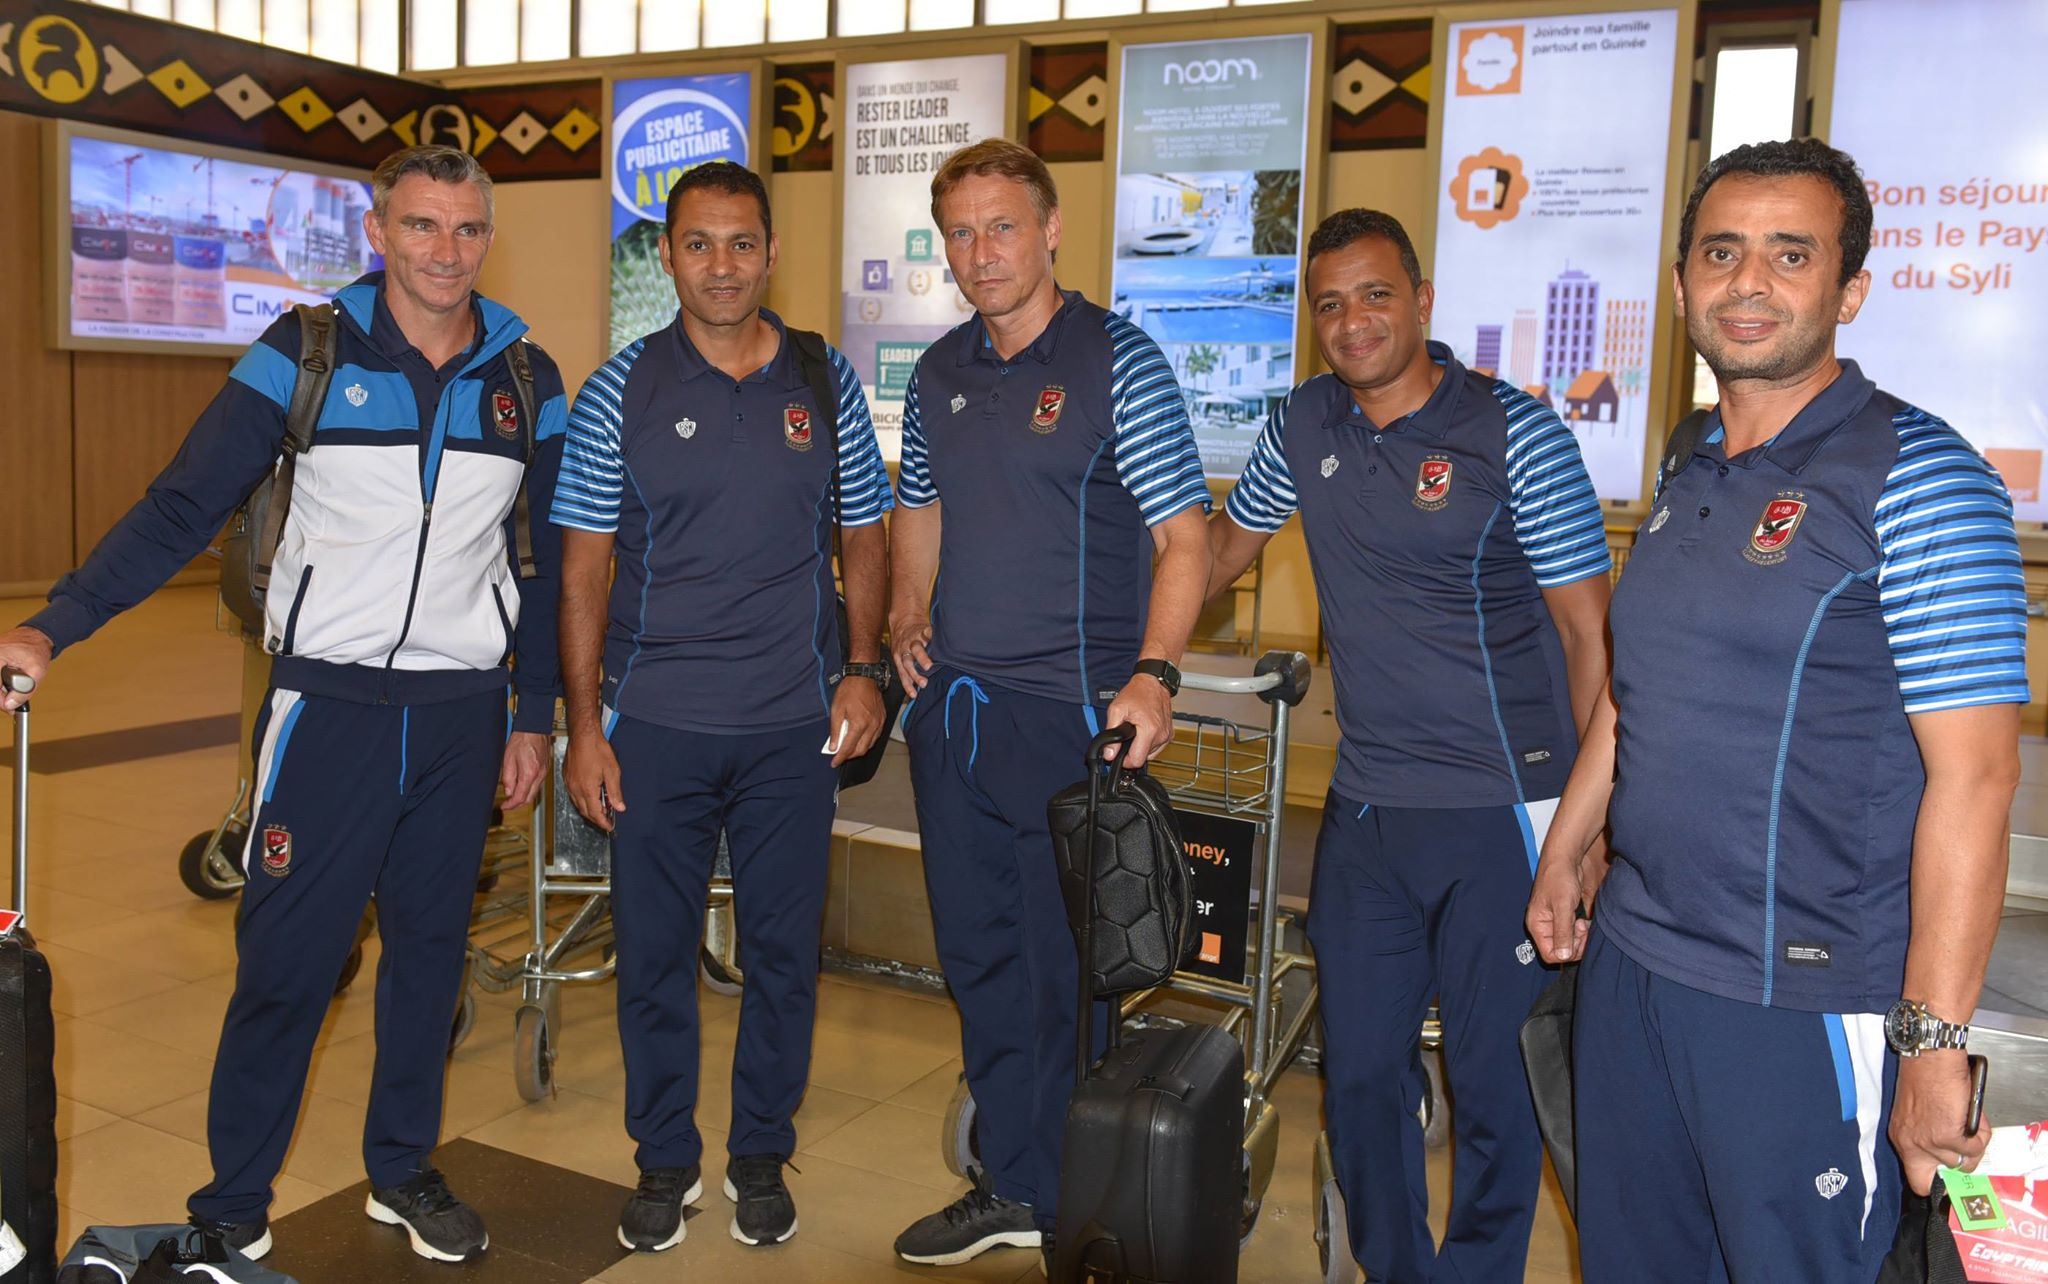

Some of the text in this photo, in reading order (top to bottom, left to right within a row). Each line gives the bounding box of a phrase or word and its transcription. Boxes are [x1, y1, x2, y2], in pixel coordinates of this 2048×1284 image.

[1534, 20, 1650, 39] Joindre ma famille
[1532, 37, 1647, 56] partout en Guinée
[857, 97, 949, 123] RESTER LEADER
[645, 110, 704, 143] ESPACE
[856, 122, 970, 149] EST UN CHALLENGE
[624, 127, 731, 172] PUBLICITAIRE
[856, 155, 870, 175] DE
[873, 153, 904, 174] TOUS
[907, 152, 927, 172] LES
[1864, 181, 1926, 206] Bon
[1935, 221, 1965, 247] le
[1892, 262, 2012, 296] du Syli
[232, 293, 288, 316] CIM
[1183, 841, 1230, 866] ney,
